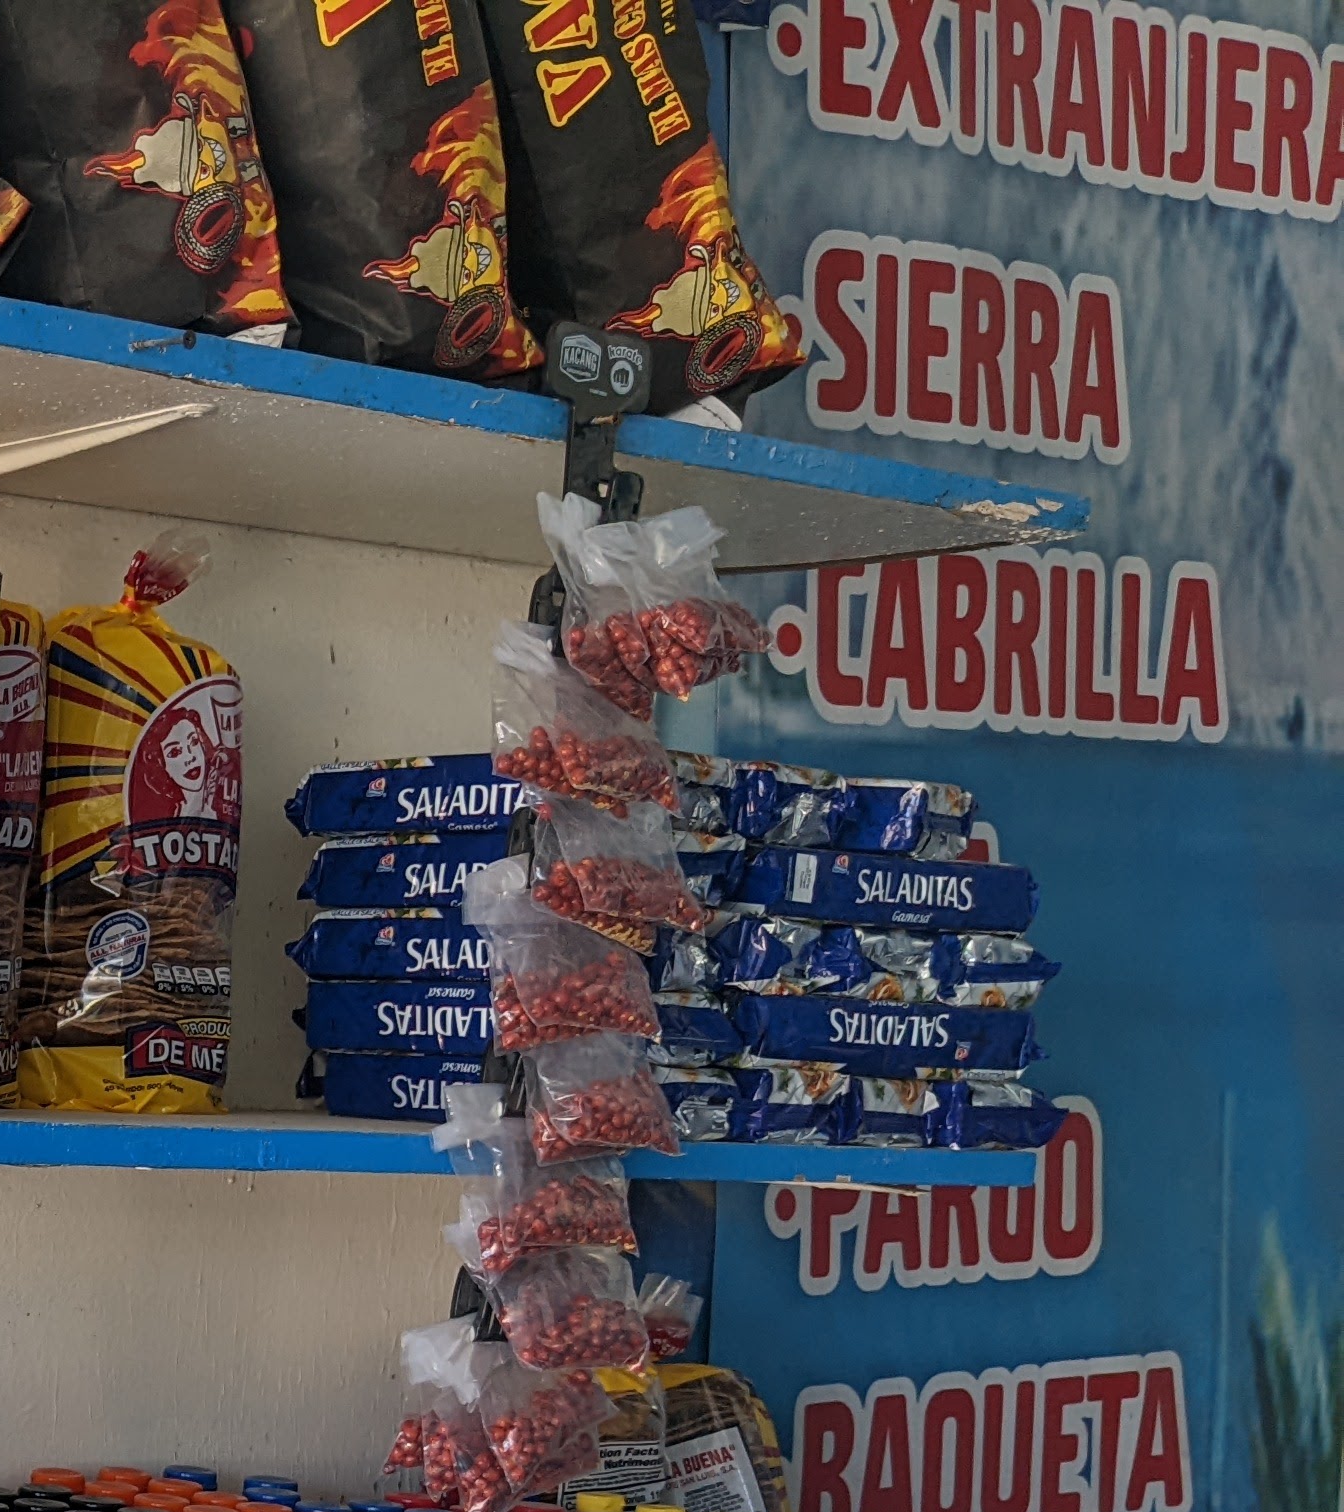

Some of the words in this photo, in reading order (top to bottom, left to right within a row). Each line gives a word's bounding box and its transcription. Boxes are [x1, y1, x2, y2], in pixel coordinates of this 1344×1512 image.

[820, 0, 1344, 205] EXTRANJERA
[563, 344, 598, 371] KACANG
[608, 346, 642, 369] karate
[815, 248, 1120, 449] SIERRA
[816, 554, 1220, 727] CABRILLA
[854, 868, 974, 911] SALADITAS
[891, 911, 930, 924] Gamesa
[828, 1008, 950, 1048] SALADITAS
[148, 1038, 185, 1066] DE
